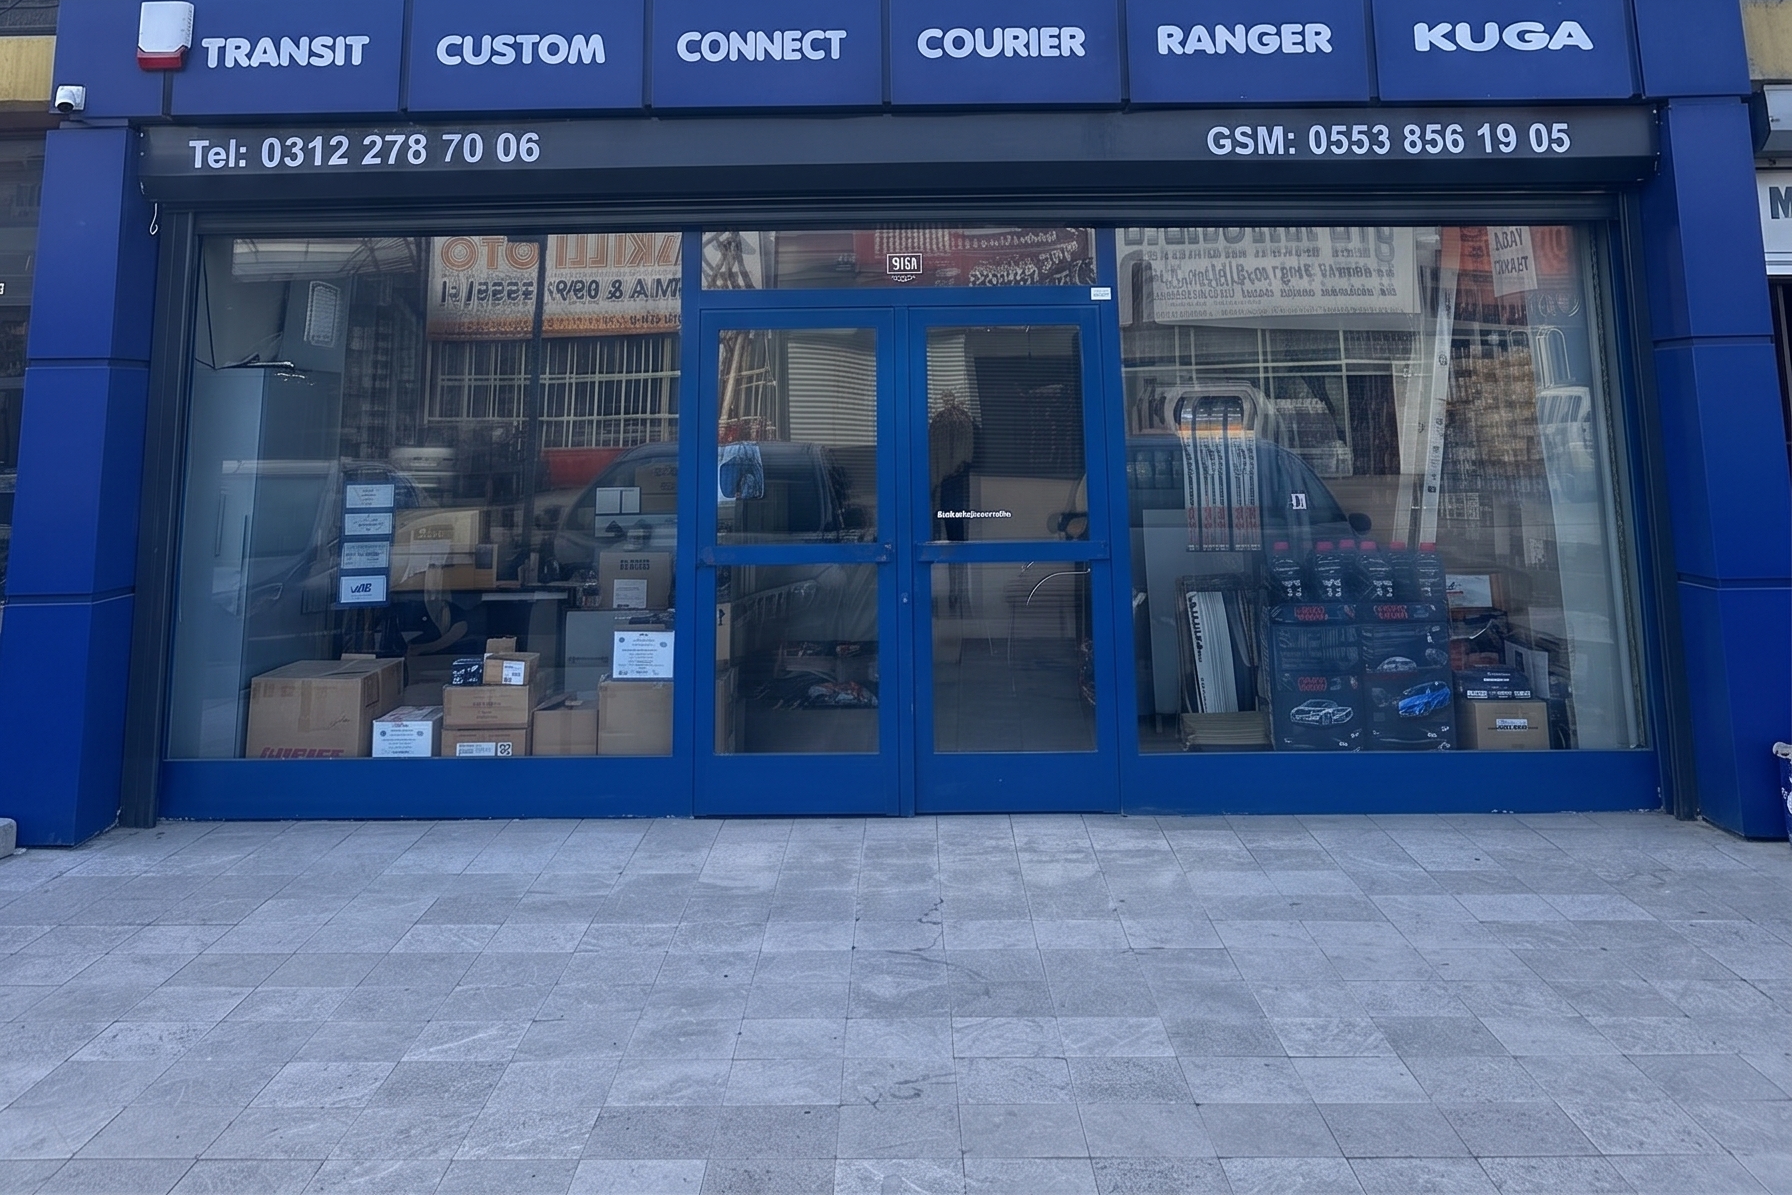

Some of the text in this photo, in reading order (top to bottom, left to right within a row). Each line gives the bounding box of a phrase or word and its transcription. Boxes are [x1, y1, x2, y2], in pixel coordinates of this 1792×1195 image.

[201, 35, 370, 69] TRANSIT
[436, 34, 606, 66] CUSTOM
[676, 29, 847, 62] CONNECT
[917, 26, 1086, 59] COURIER
[1157, 23, 1333, 55] RANGER
[1413, 21, 1594, 52] KUGA
[188, 132, 540, 169] Tel: 0312 278 70 06
[1207, 122, 1571, 155] GSM: 0553 856 19 05
